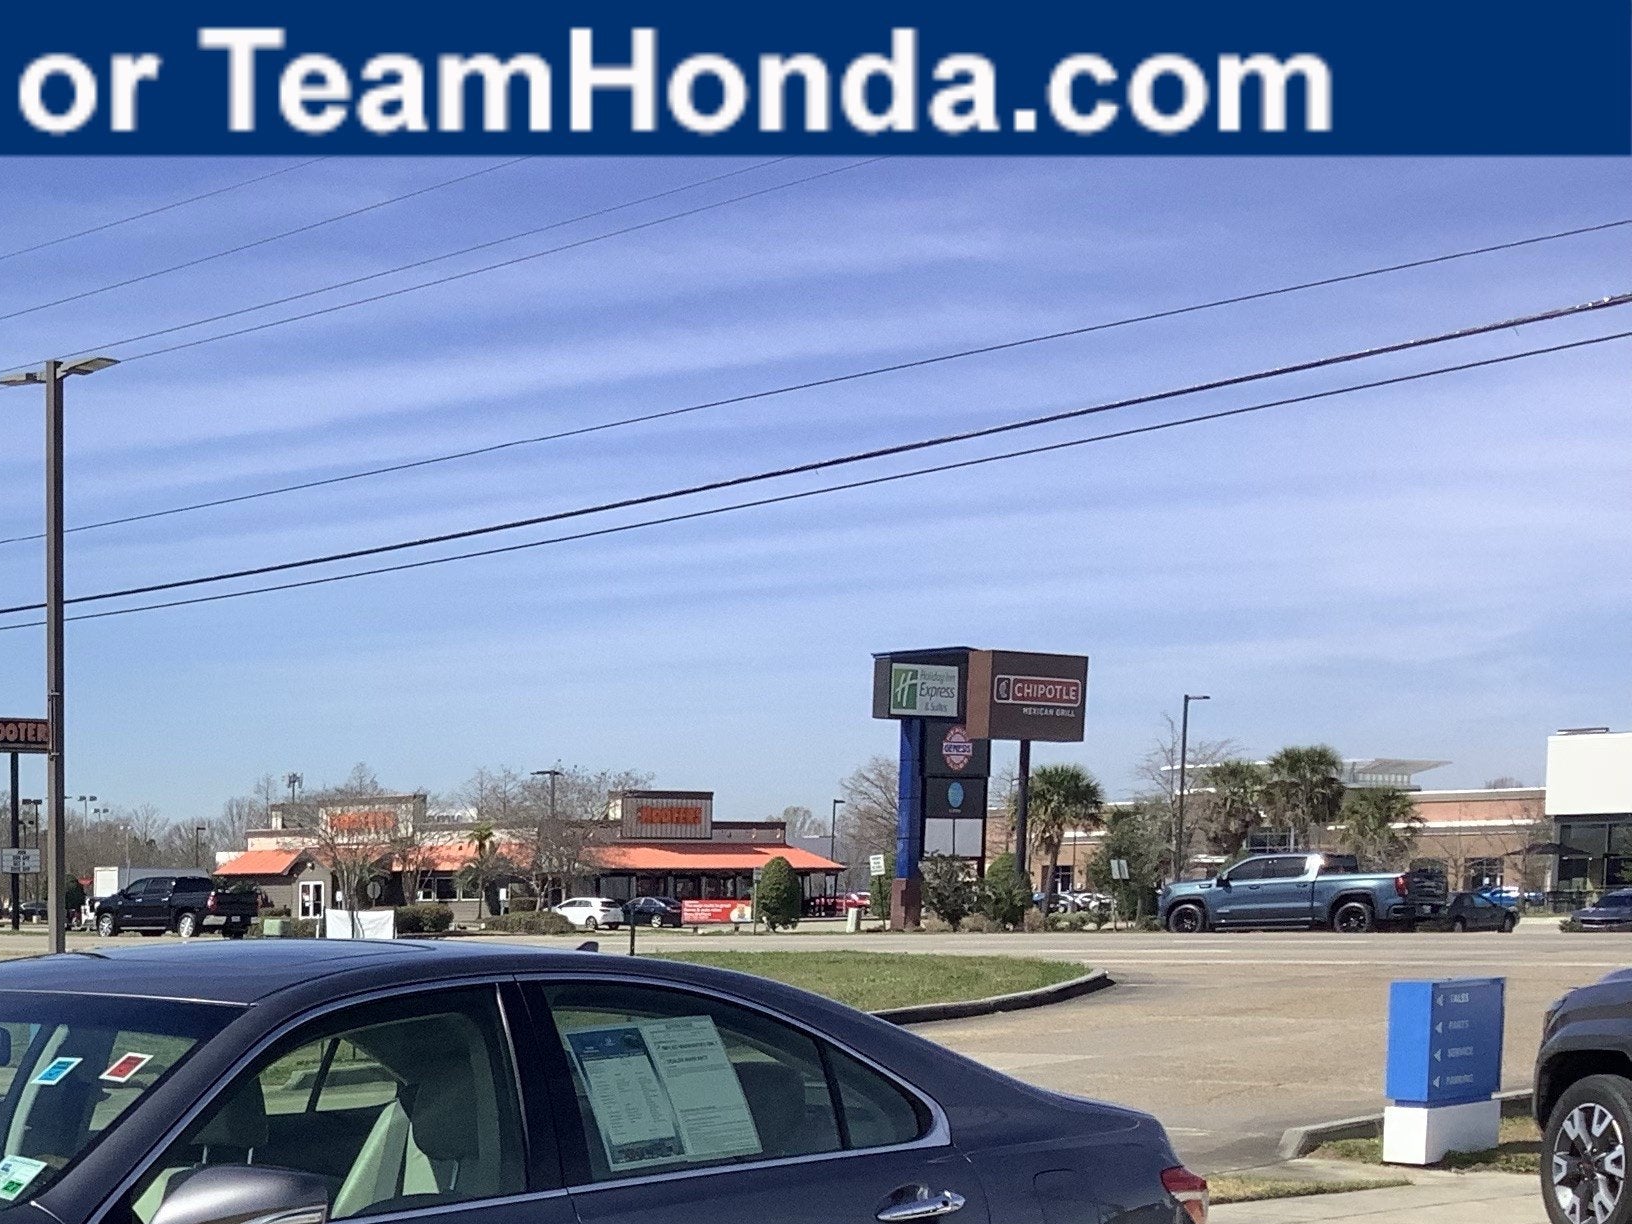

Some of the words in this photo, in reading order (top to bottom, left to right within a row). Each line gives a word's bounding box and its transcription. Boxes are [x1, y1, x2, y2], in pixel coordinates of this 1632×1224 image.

[919, 669, 943, 685] Holiday
[944, 672, 956, 681] Inn
[919, 684, 956, 700] Express
[1014, 683, 1077, 700] CHIPOTLE
[1022, 707, 1055, 716] MEXICAN
[1056, 708, 1076, 718] GRILL
[4, 1181, 20, 1192] 27
